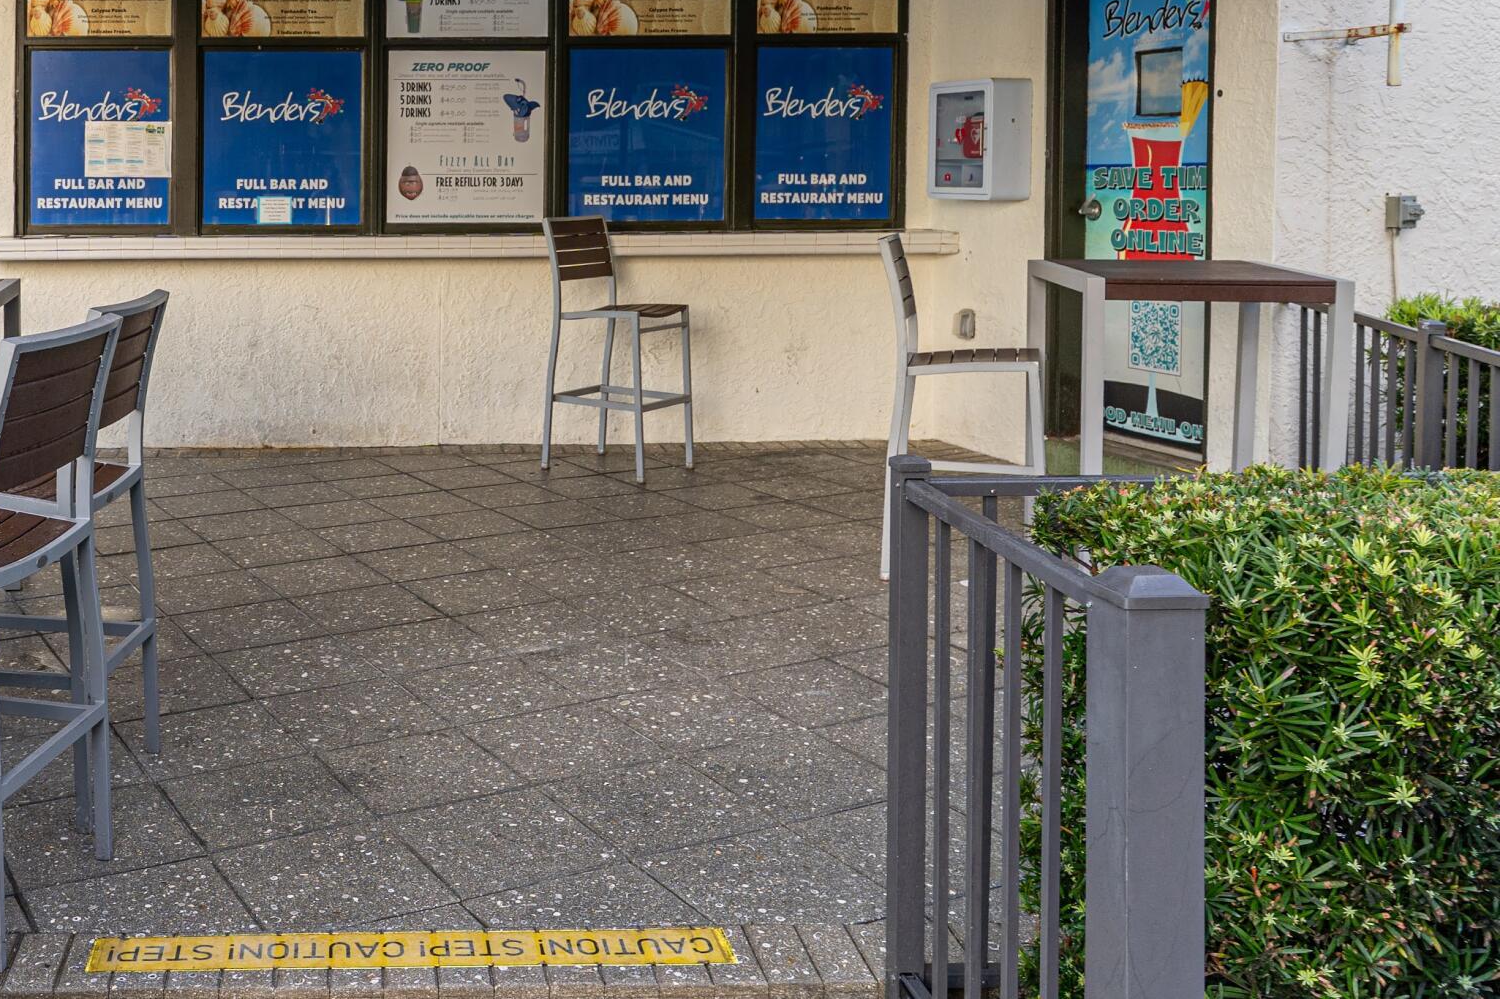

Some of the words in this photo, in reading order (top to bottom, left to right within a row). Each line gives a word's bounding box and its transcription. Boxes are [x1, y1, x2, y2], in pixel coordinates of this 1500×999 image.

[412, 63, 444, 71] ZERO
[448, 63, 490, 71] PROOF
[400, 82, 405, 92] 3
[406, 82, 432, 92] DRINKS
[400, 95, 405, 105] 5
[406, 95, 432, 105] DRINKS
[586, 88, 685, 120] Blenders
[764, 86, 861, 118] Blenders
[38, 90, 138, 122] Blenders
[220, 90, 322, 123] Blenders
[400, 108, 404, 117] 7
[406, 108, 431, 117] DRINKS
[436, 177, 453, 187] FREE
[455, 177, 481, 187] REFILLS
[483, 177, 497, 187] FOR
[500, 177, 505, 187] 3
[505, 177, 523, 187] DAYS
[602, 175, 631, 186] FULL
[635, 175, 660, 186] BAR
[664, 175, 692, 186] AND
[778, 174, 807, 185] FULL
[810, 174, 836, 185] BAR
[839, 174, 867, 185] AND
[1093, 166, 1153, 190] SAVE
[1160, 166, 1207, 190] TIM
[54, 179, 85, 190] FULL
[88, 179, 114, 190] BAR
[117, 179, 145, 190] AND
[236, 179, 266, 190] FULL
[270, 179, 296, 190] BAR
[300, 179, 328, 190] AND
[37, 198, 123, 209] RESTAURANT
[126, 198, 163, 209] MENU
[219, 198, 305, 209] RESTANT
[308, 198, 345, 209] MENU
[584, 194, 669, 205] RESTAURANT
[672, 194, 708, 205] MENU
[761, 193, 844, 204] RESTAURANT
[847, 193, 883, 204] MENU
[1113, 198, 1201, 223] ORDER
[1111, 228, 1204, 256] ONLINE
[1103, 405, 1126, 424] OD
[1130, 411, 1176, 435] MENU
[228, 941, 405, 960] CAUTION!
[420, 938, 524, 957] STEP!
[539, 937, 714, 956] CAUTION!
[106, 944, 213, 962] STEP!
